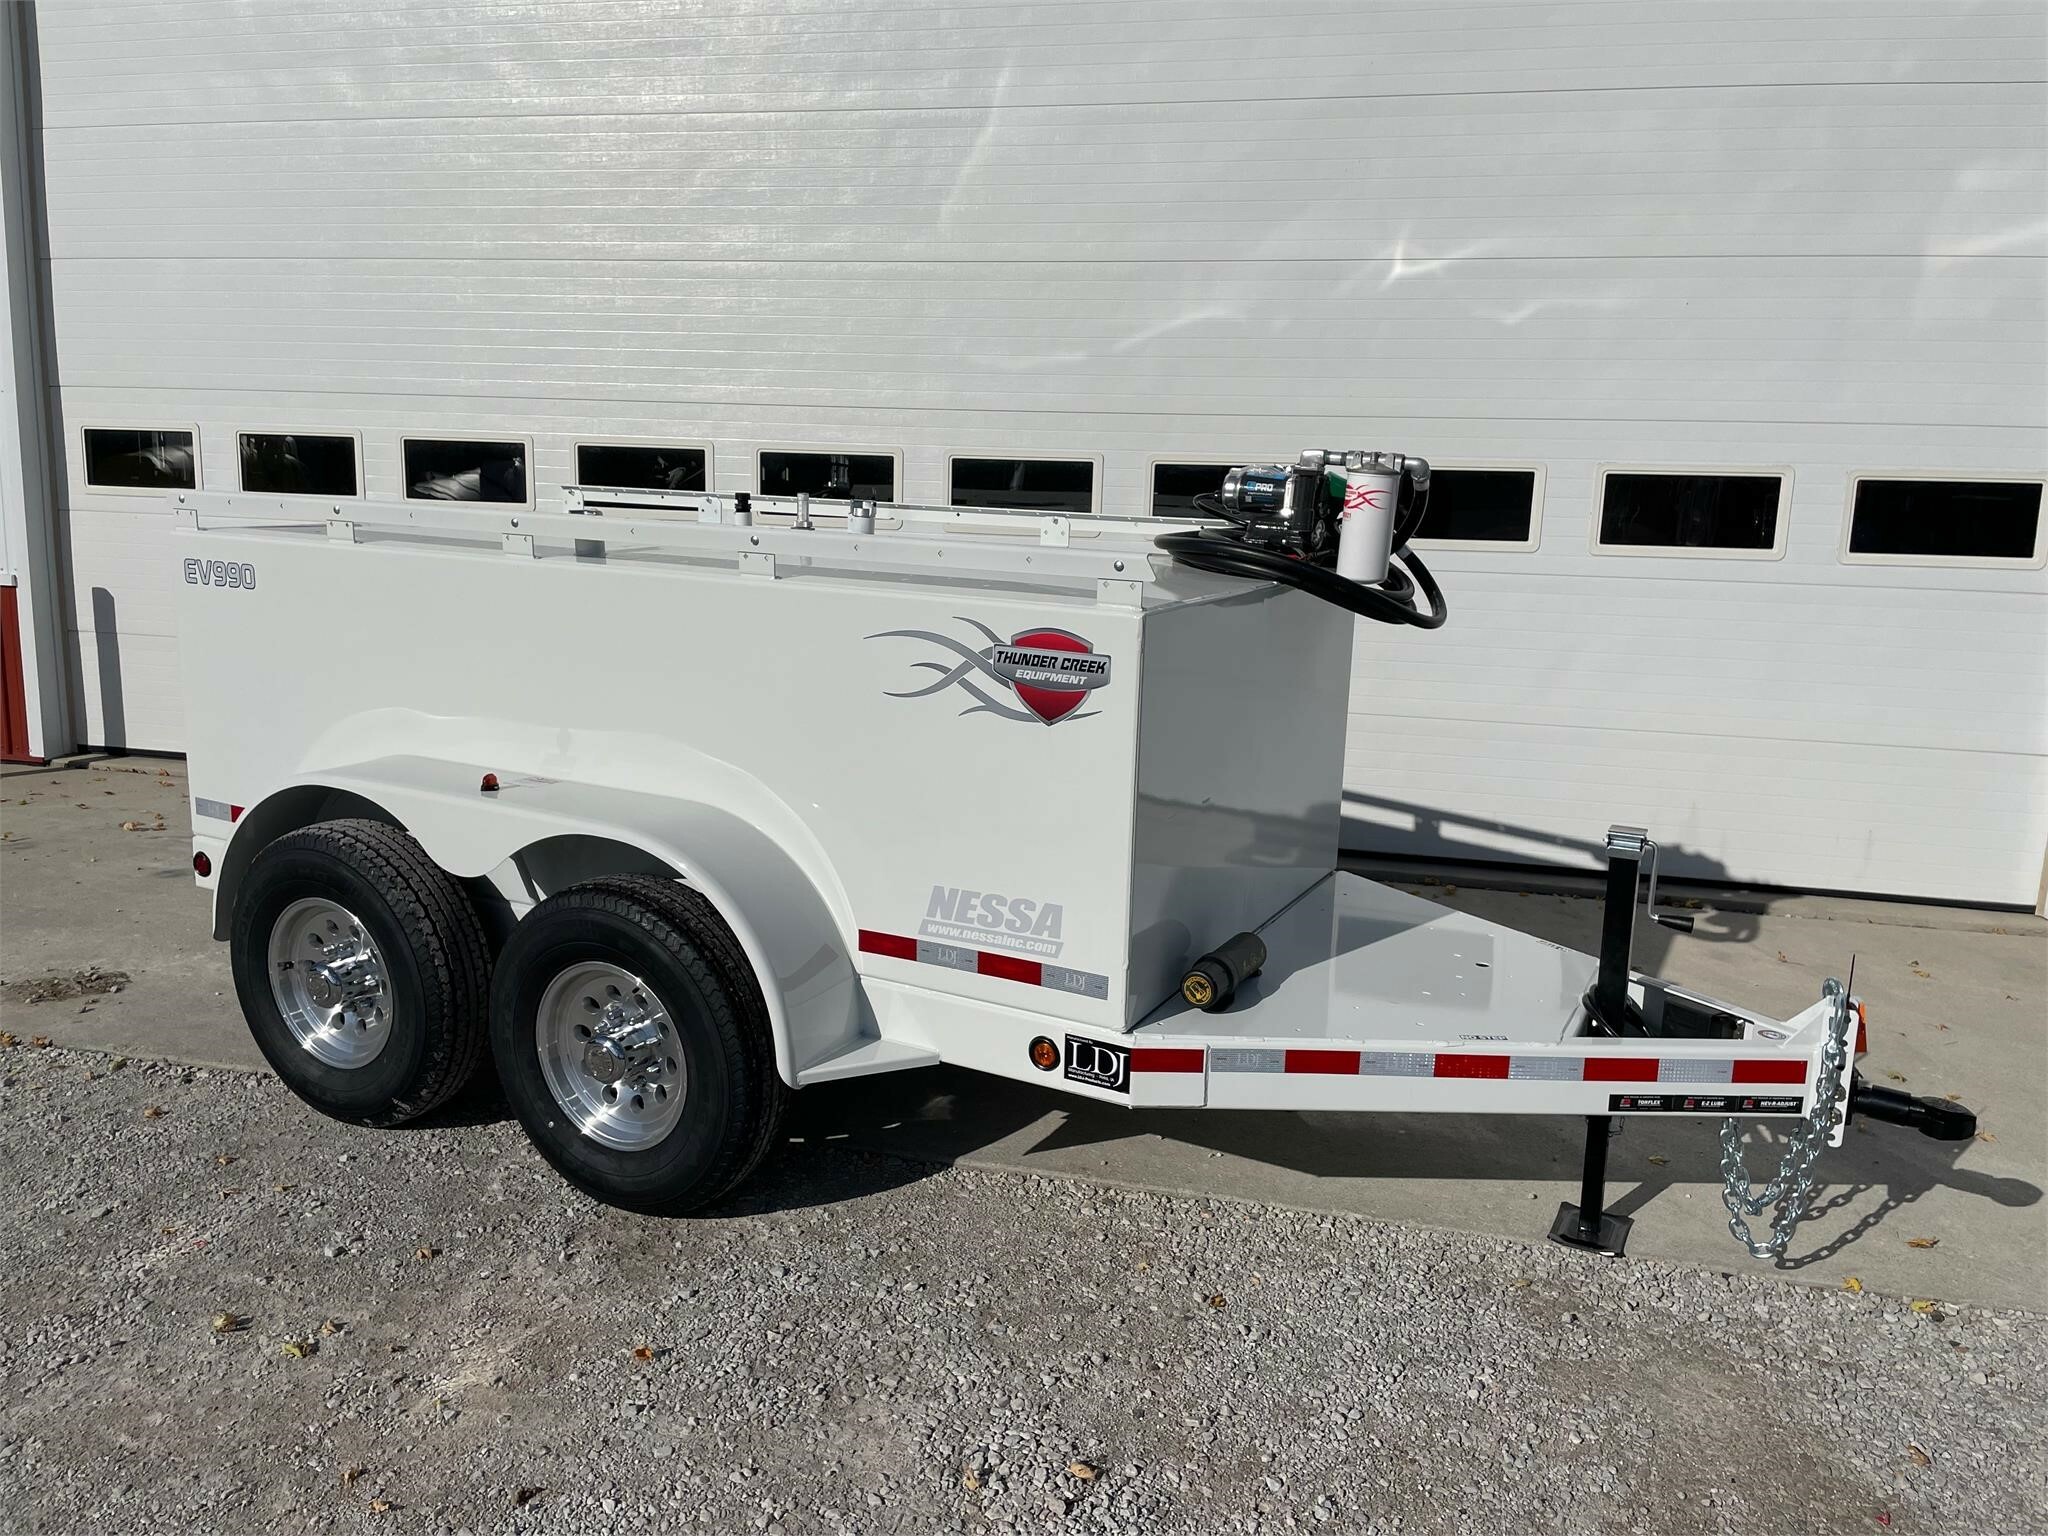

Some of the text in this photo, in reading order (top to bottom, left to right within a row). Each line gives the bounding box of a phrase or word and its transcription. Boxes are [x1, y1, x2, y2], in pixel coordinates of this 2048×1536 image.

[184, 558, 256, 590] EV990
[996, 650, 1107, 674] THUNDER CREEK
[1015, 669, 1088, 685] EQUIPMENT
[926, 885, 1063, 939] NESSA
[927, 922, 1057, 955] www.nessainc.com
[1068, 1040, 1130, 1087] LDJ
